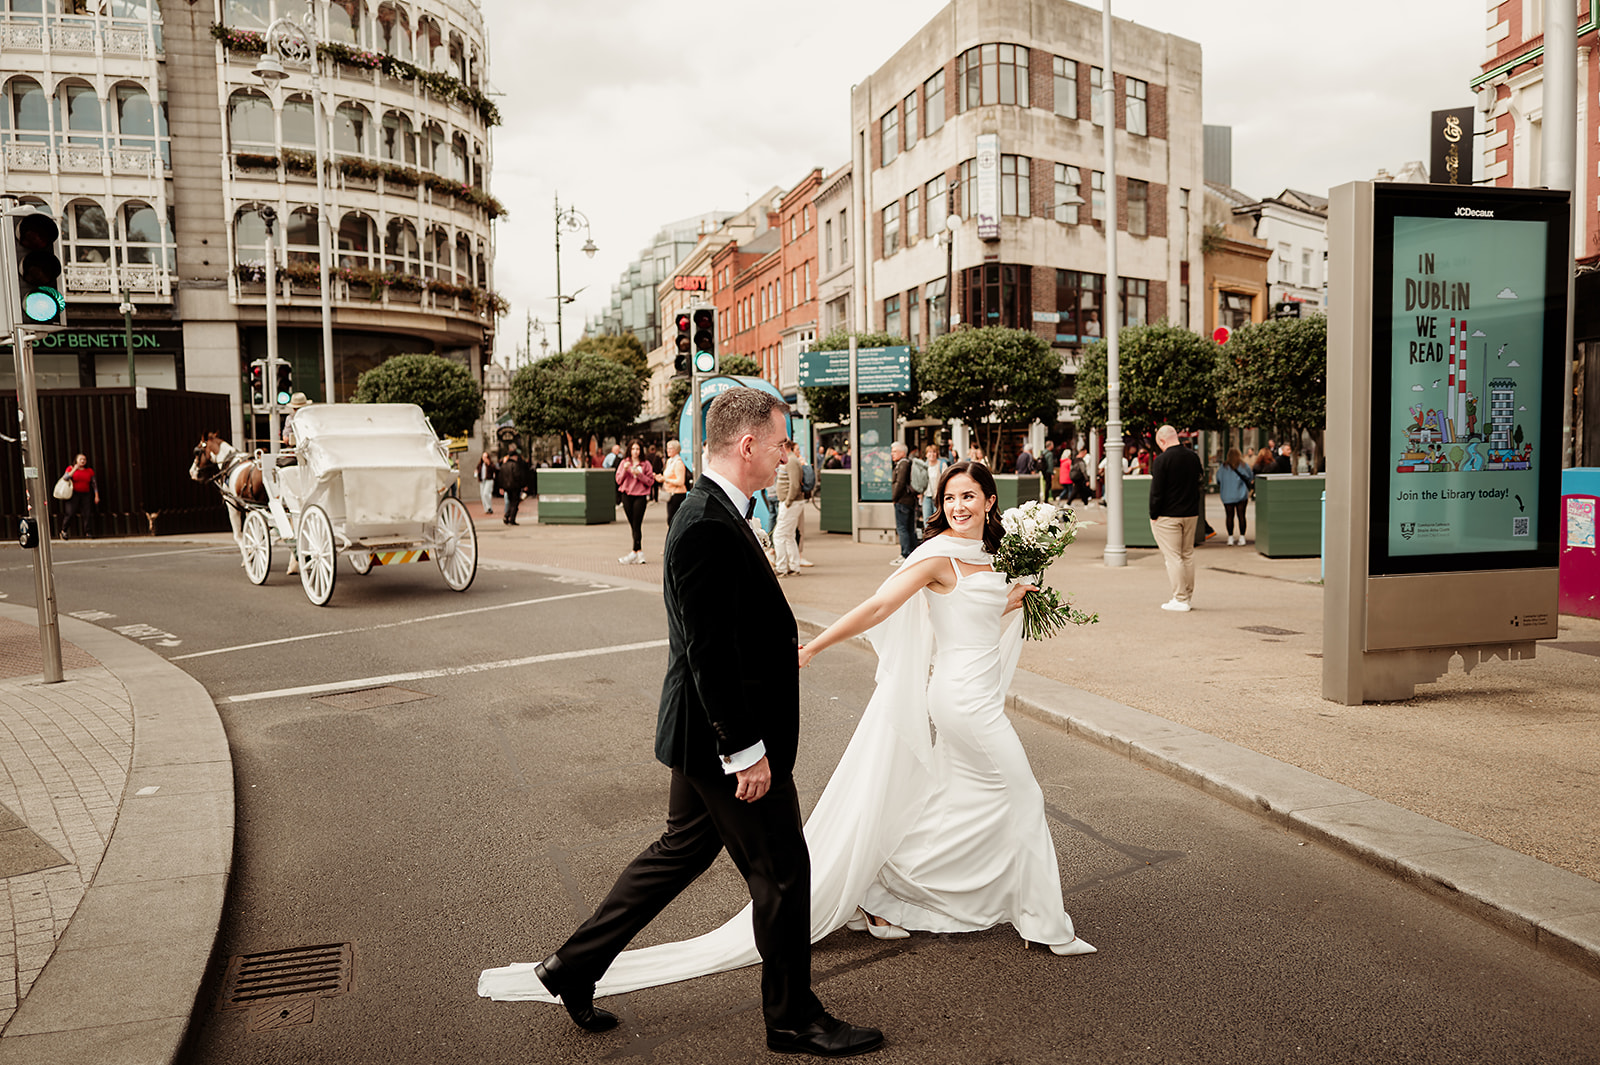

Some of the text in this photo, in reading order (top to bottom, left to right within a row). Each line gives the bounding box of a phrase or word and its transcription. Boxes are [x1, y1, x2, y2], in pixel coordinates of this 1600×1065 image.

[1454, 206, 1494, 218] JCDecaux
[1418, 252, 1435, 275] IN
[1416, 315, 1437, 339] WE
[42, 333, 66, 348] OF
[1409, 340, 1443, 365] READ
[1396, 487, 1510, 501] Join the Library today!
